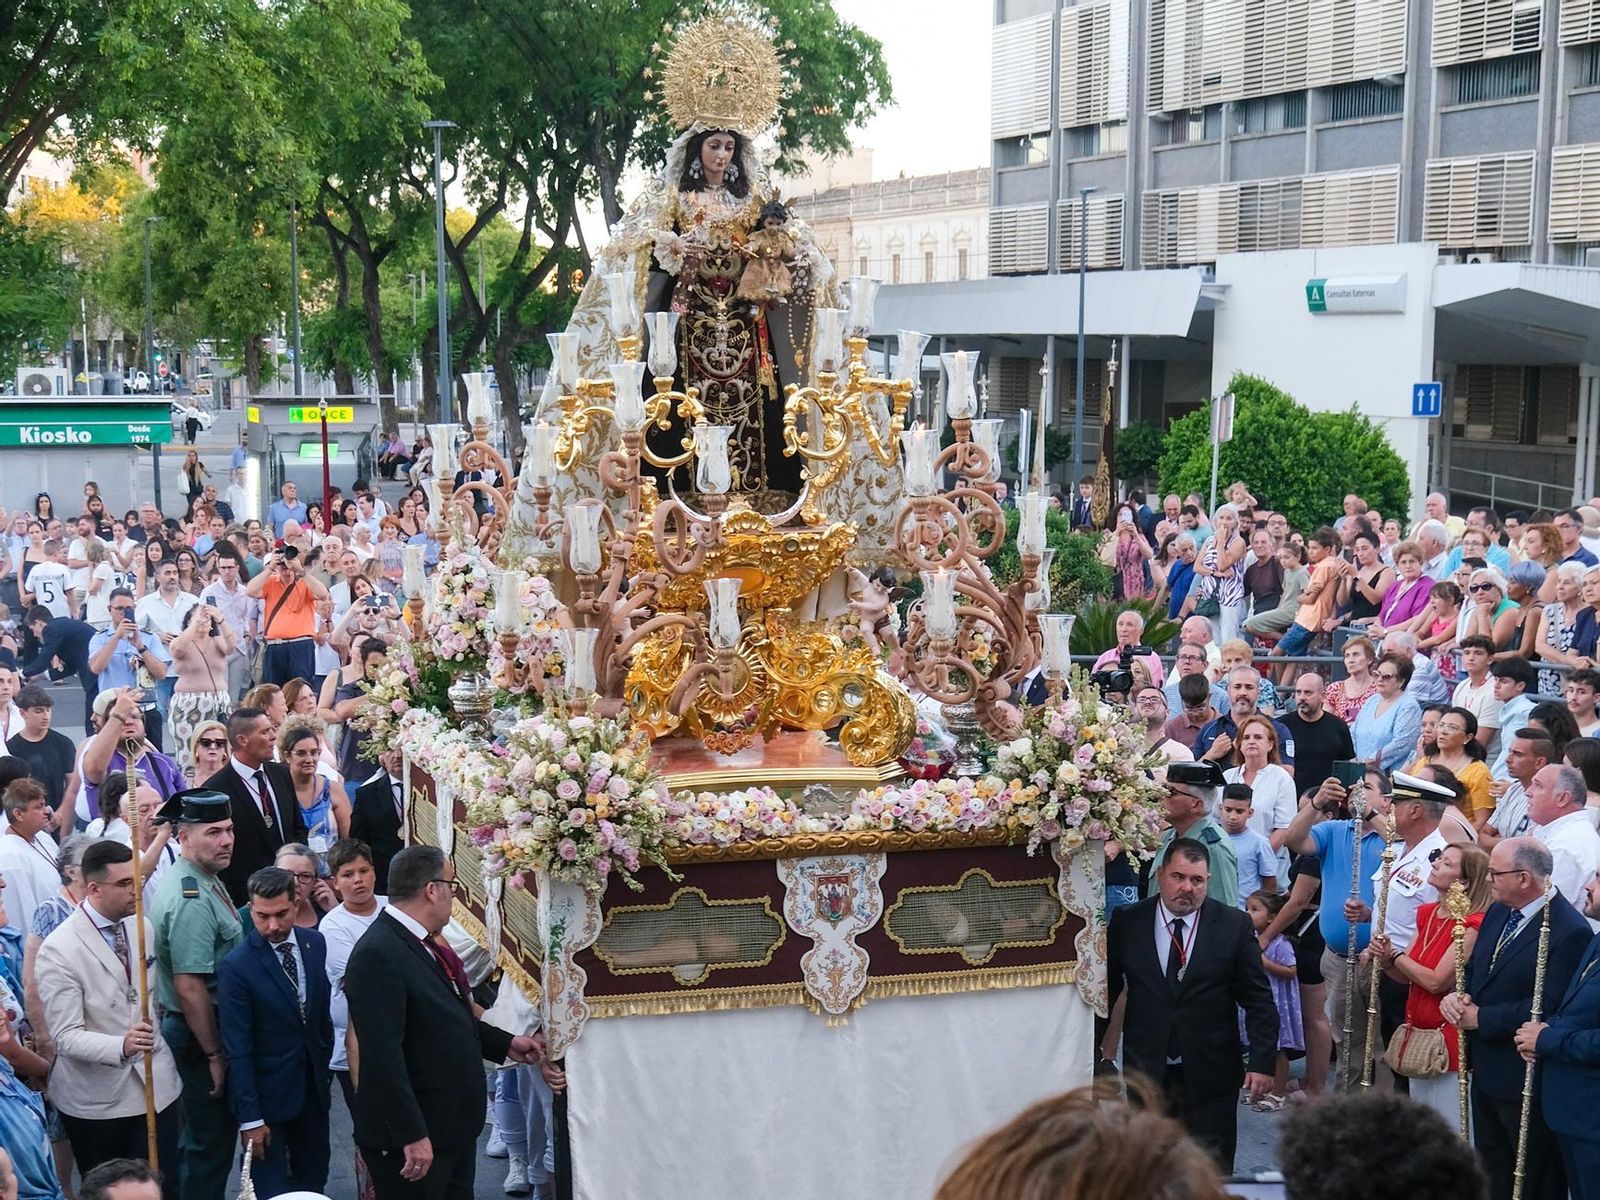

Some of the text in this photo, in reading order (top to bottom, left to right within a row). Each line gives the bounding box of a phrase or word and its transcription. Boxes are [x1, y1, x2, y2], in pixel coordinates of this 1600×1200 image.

[20, 427, 92, 443] Kiosko
[131, 435, 150, 443] 1974
[43, 582, 54, 603] 5
